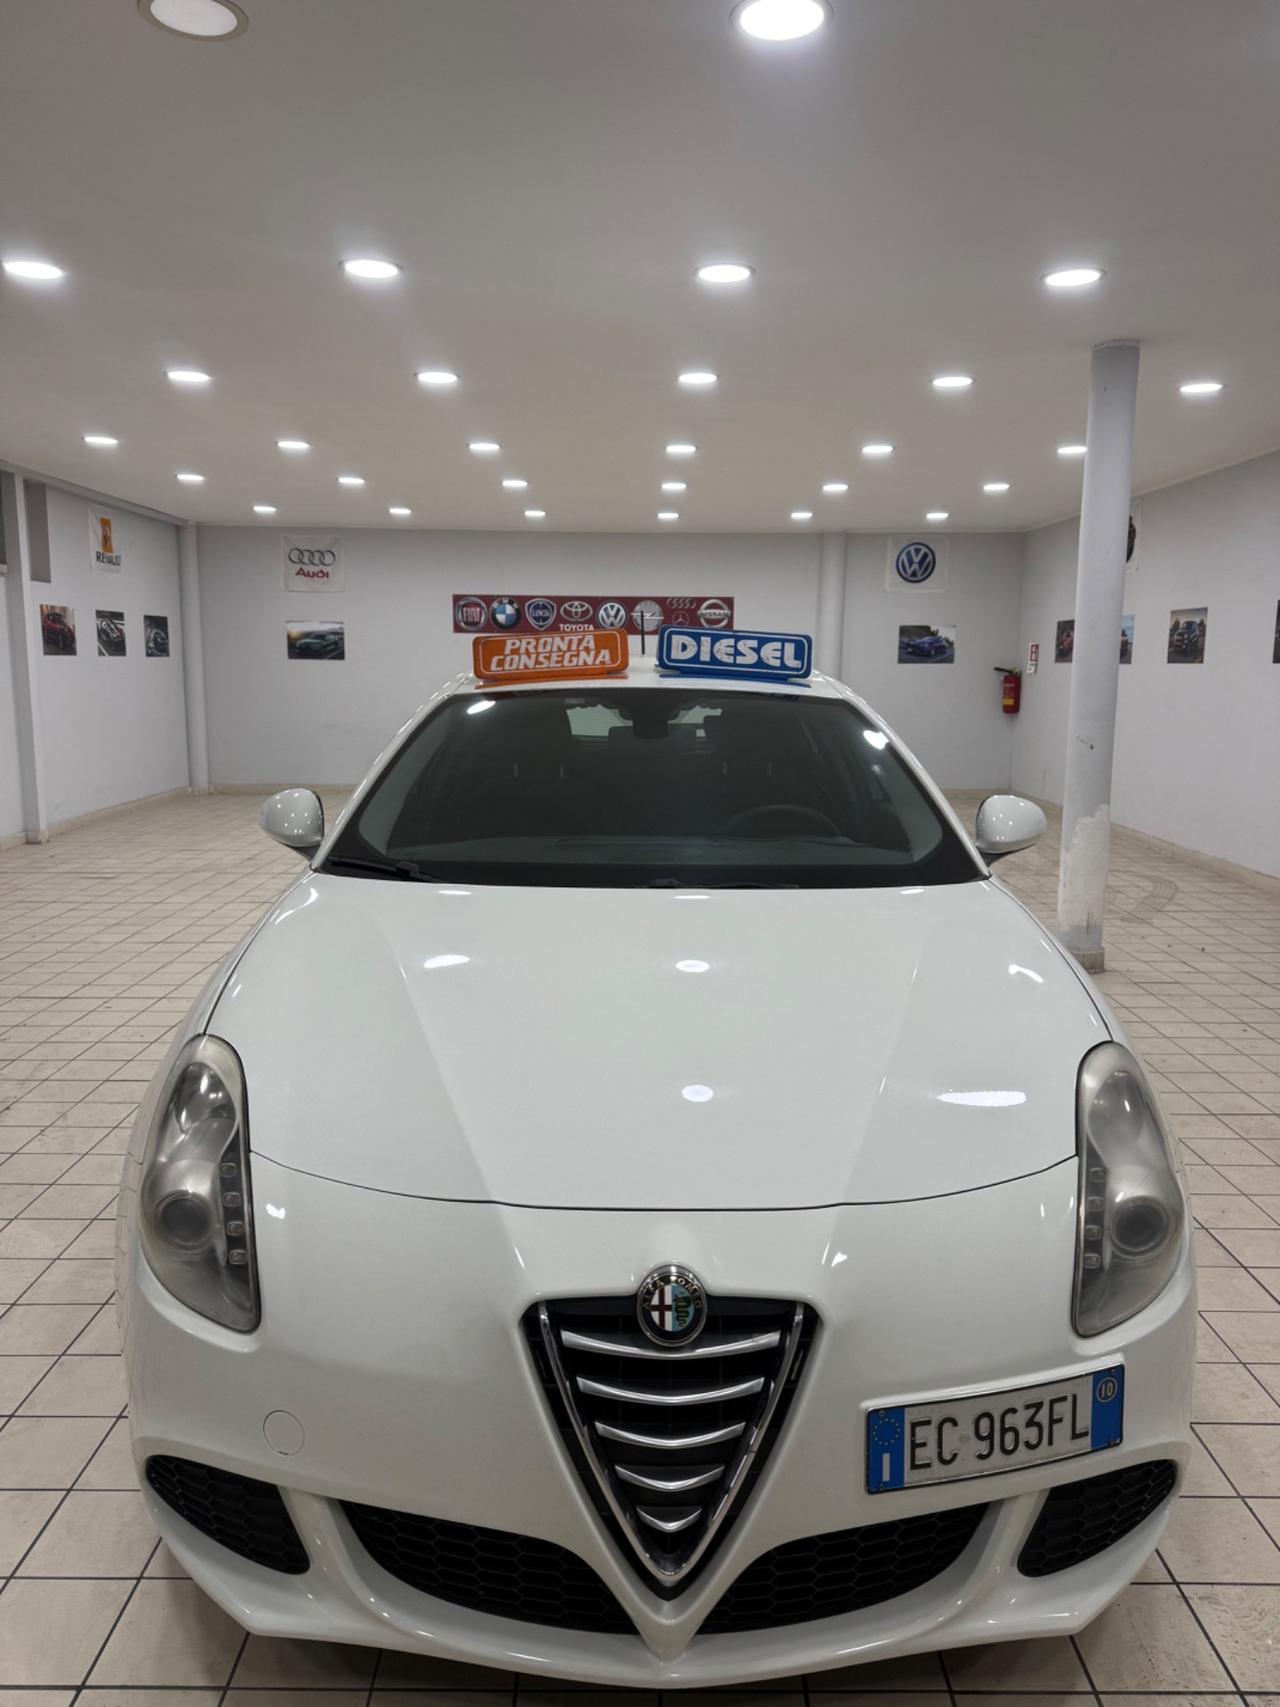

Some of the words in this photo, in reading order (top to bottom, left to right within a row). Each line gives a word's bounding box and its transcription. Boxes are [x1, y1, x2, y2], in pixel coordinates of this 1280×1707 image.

[295, 567, 329, 579] Audi
[463, 607, 480, 622] FIAT
[504, 635, 595, 655] PRONTA
[670, 635, 803, 668] DIESEL
[489, 648, 611, 672] CONSEGNA
[1101, 1381, 1114, 1397] 10
[910, 1417, 958, 1471] EC
[974, 1394, 1089, 1460] 963FL
[882, 1452, 890, 1482] I
